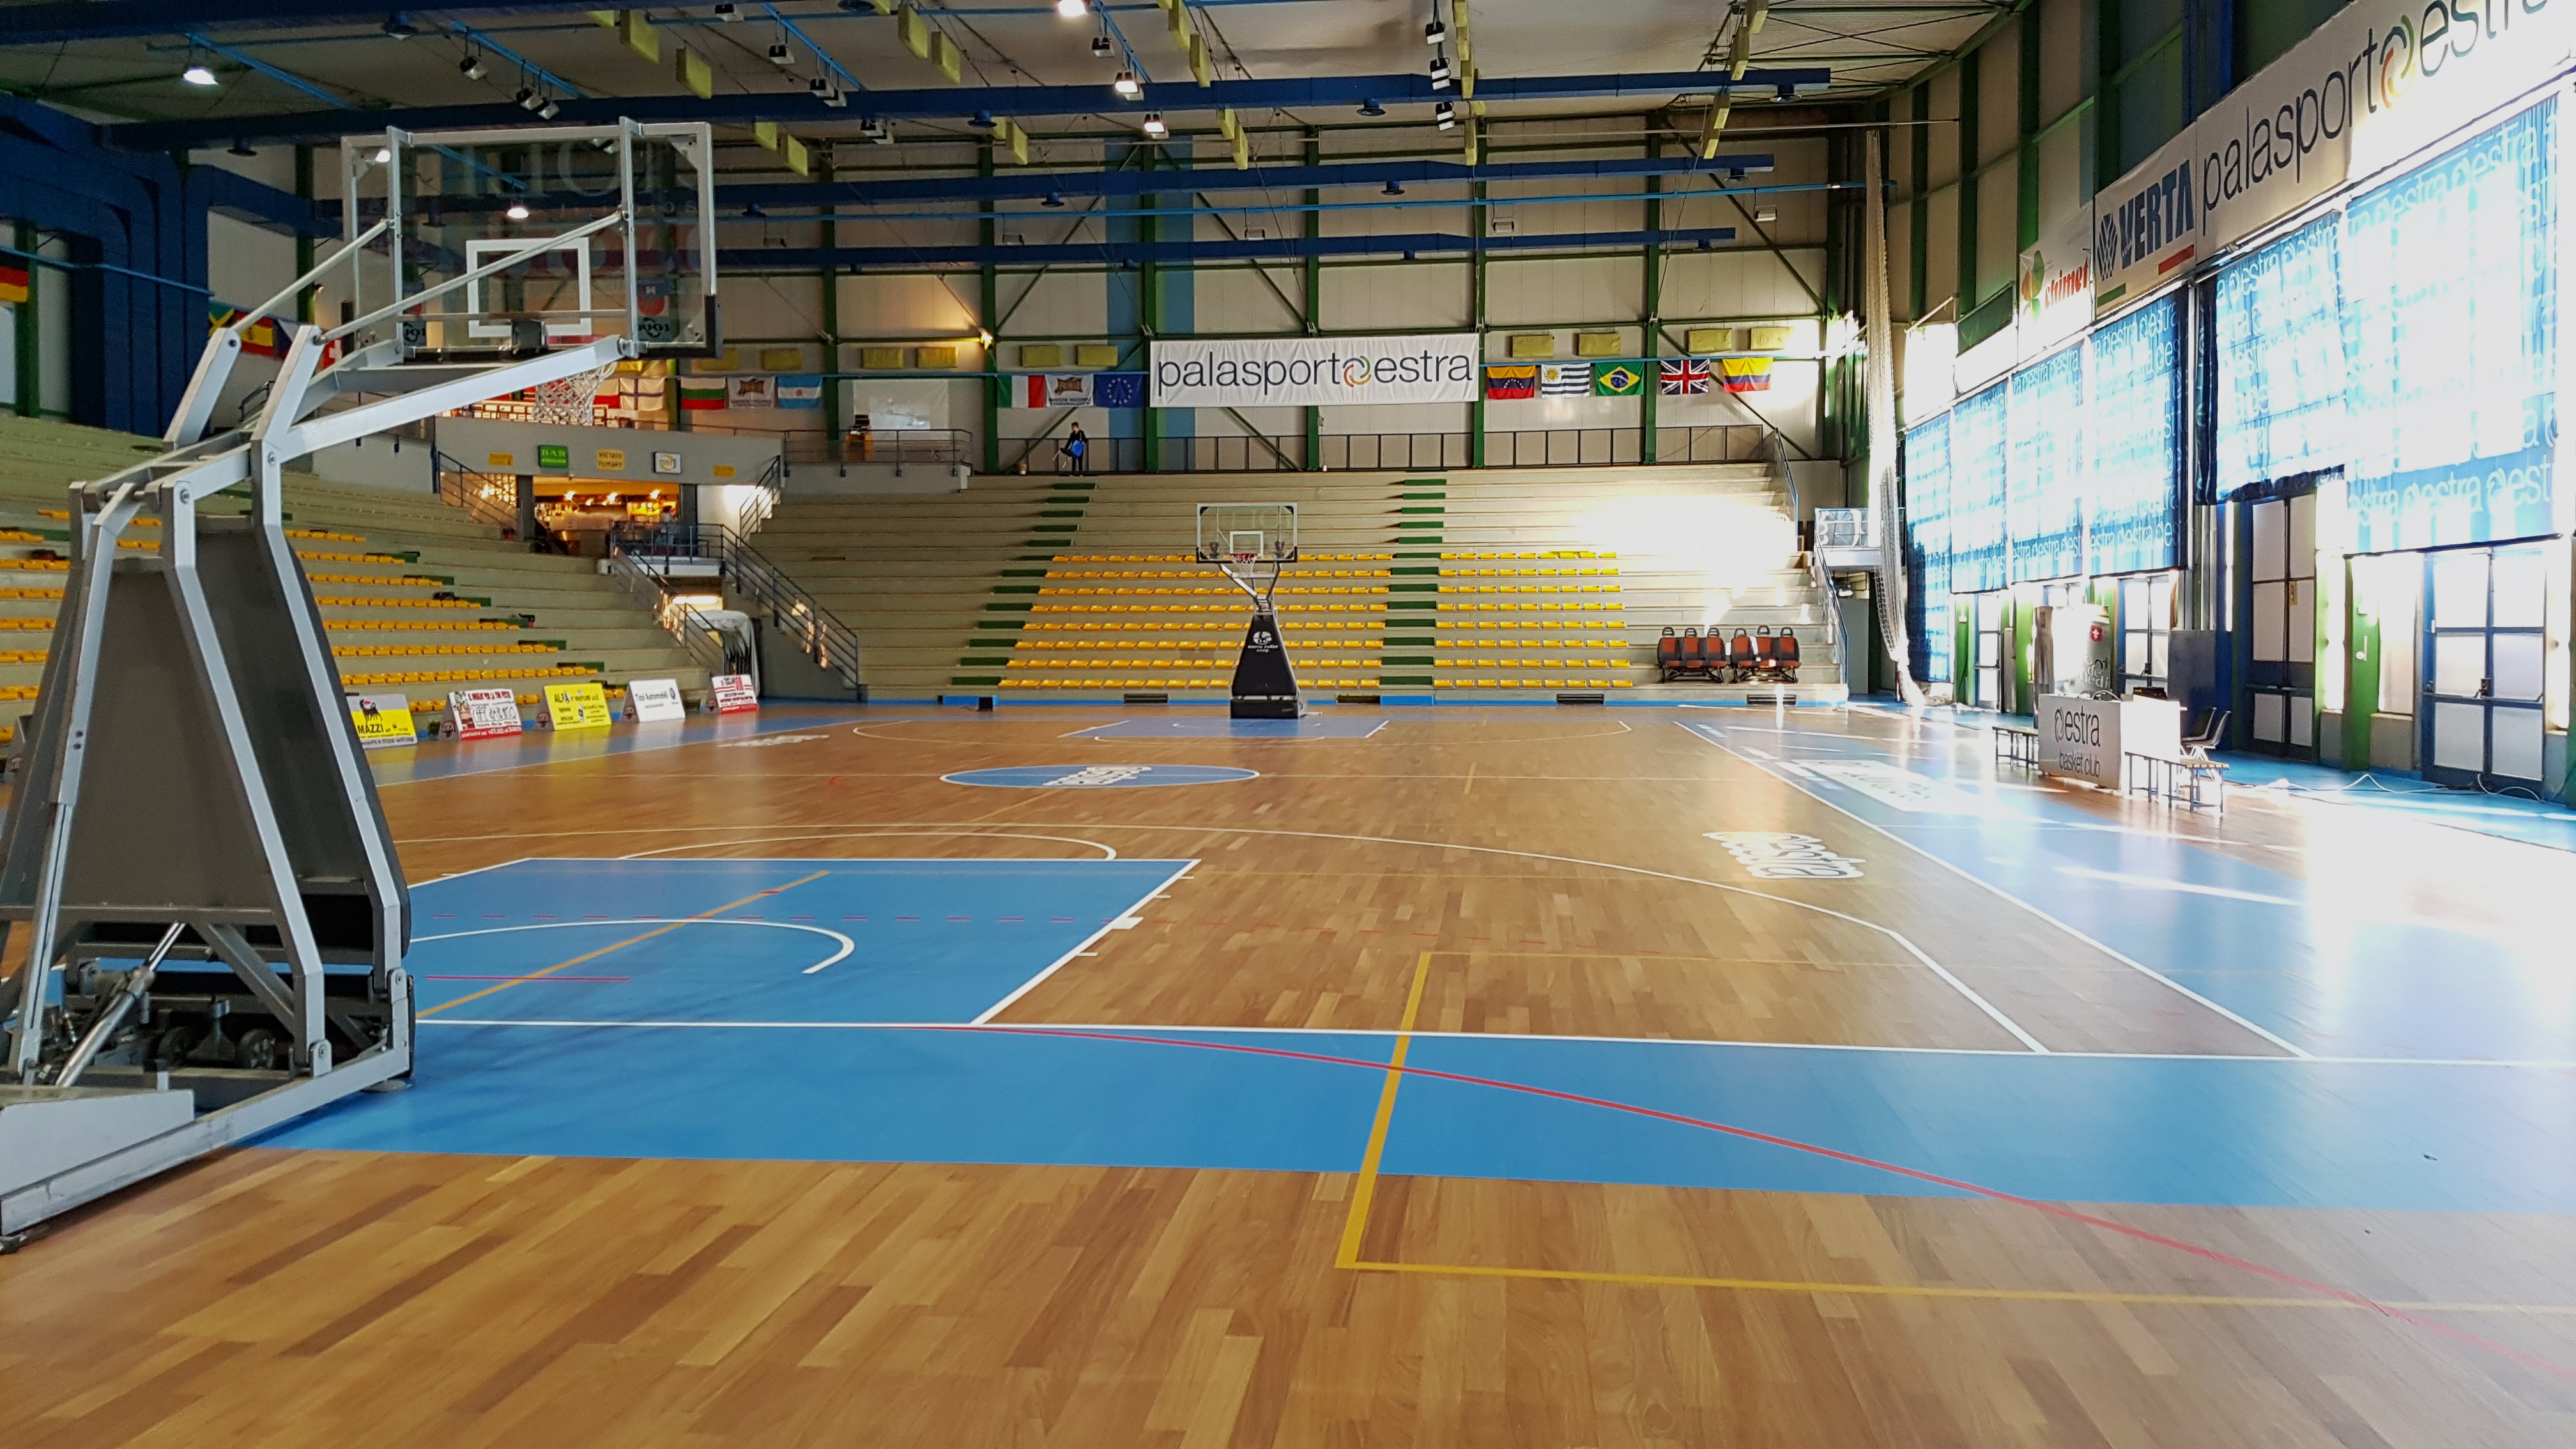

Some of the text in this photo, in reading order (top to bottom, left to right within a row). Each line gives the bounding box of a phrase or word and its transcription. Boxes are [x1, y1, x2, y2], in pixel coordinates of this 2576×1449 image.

[2119, 159, 2195, 270] VERTA
[358, 724, 383, 734] MAZZI
[2059, 748, 2101, 778] basket club
